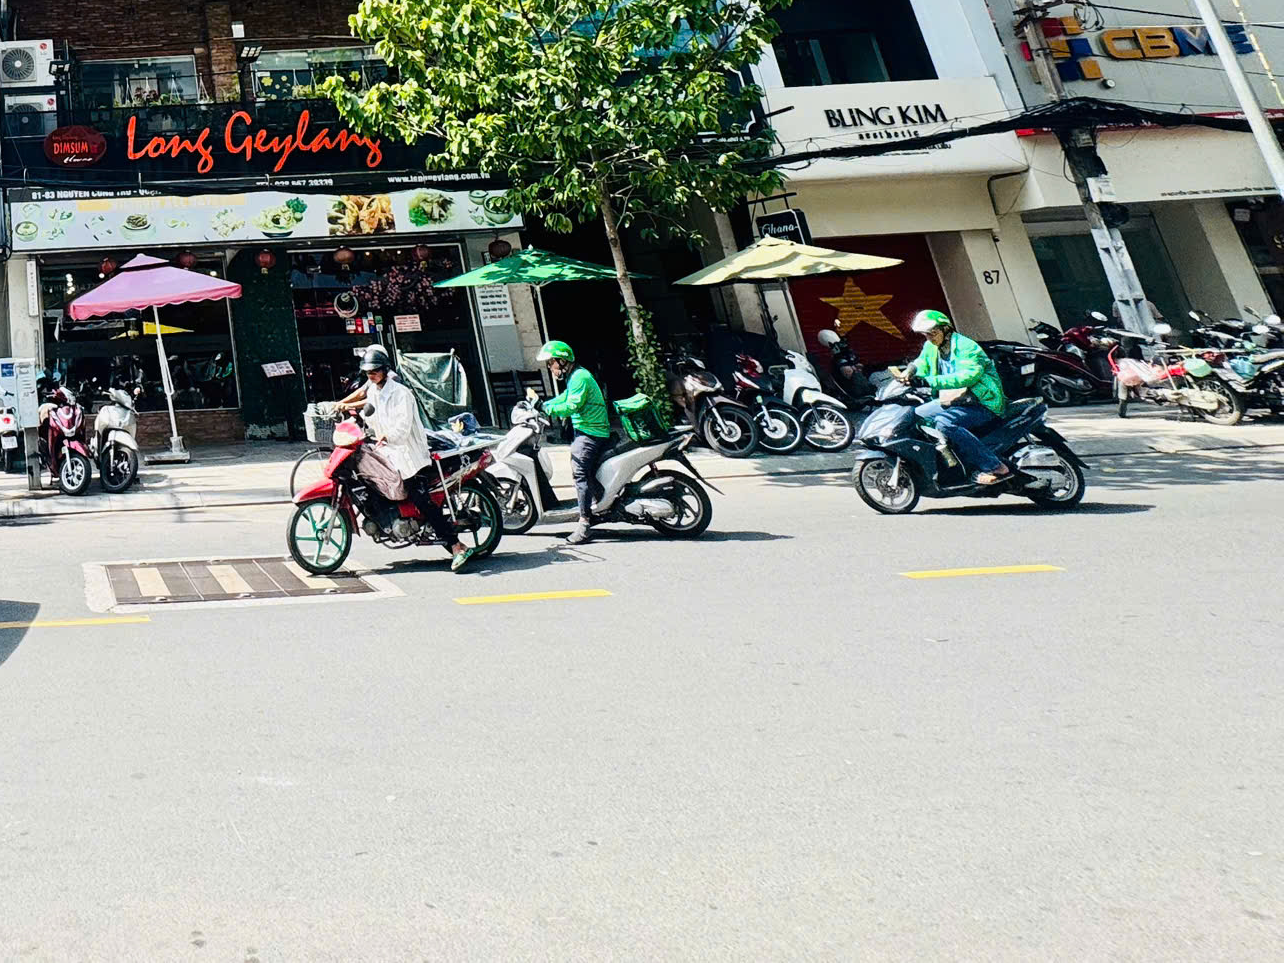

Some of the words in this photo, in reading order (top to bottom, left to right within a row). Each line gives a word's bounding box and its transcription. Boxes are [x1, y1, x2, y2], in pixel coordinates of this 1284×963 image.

[823, 106, 895, 128] BLING
[897, 103, 948, 124] KIM
[53, 140, 89, 155] DIMSUM
[127, 115, 214, 174] Long
[224, 109, 383, 173] Geylang
[983, 270, 1000, 285] 87
